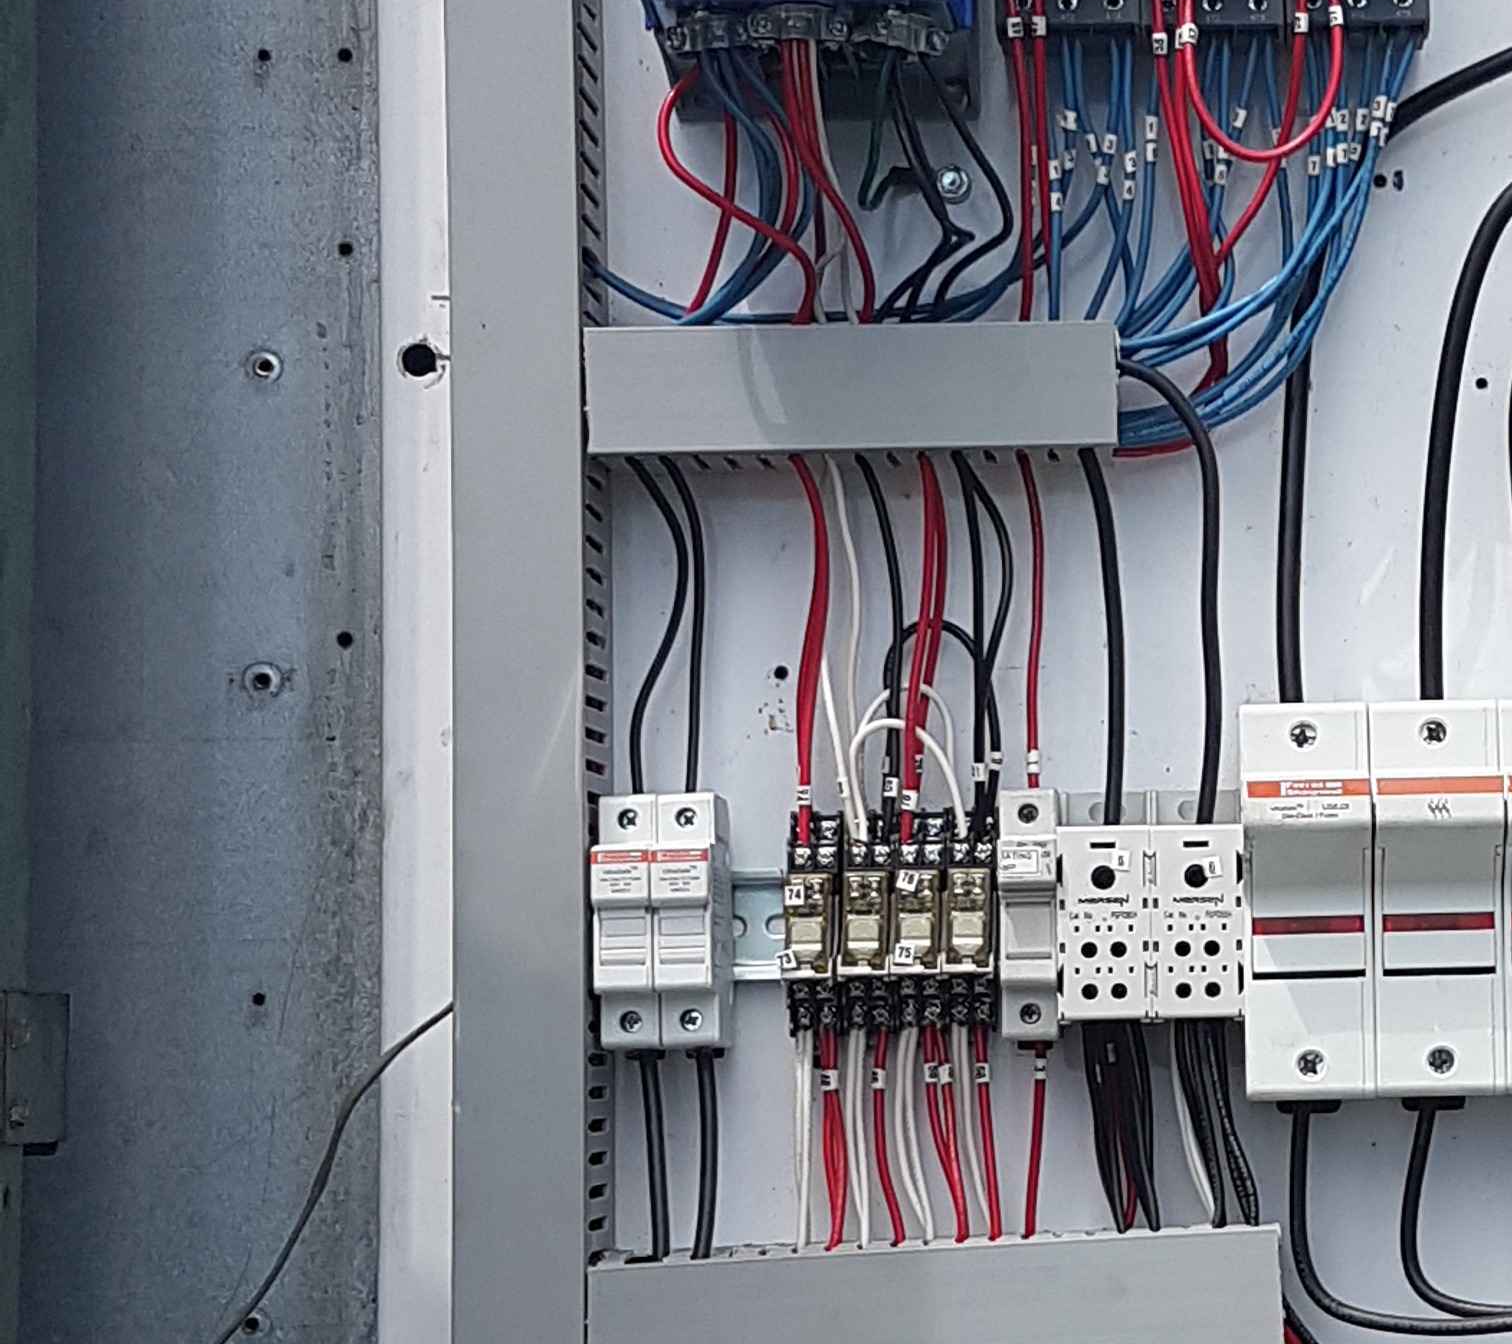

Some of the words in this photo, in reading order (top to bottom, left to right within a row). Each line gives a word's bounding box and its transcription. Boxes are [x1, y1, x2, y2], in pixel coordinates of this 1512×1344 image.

[788, 888, 801, 901] 74
[1078, 893, 1129, 907] MERSEN
[1173, 893, 1225, 906] MERSEN
[898, 947, 912, 959] 75
